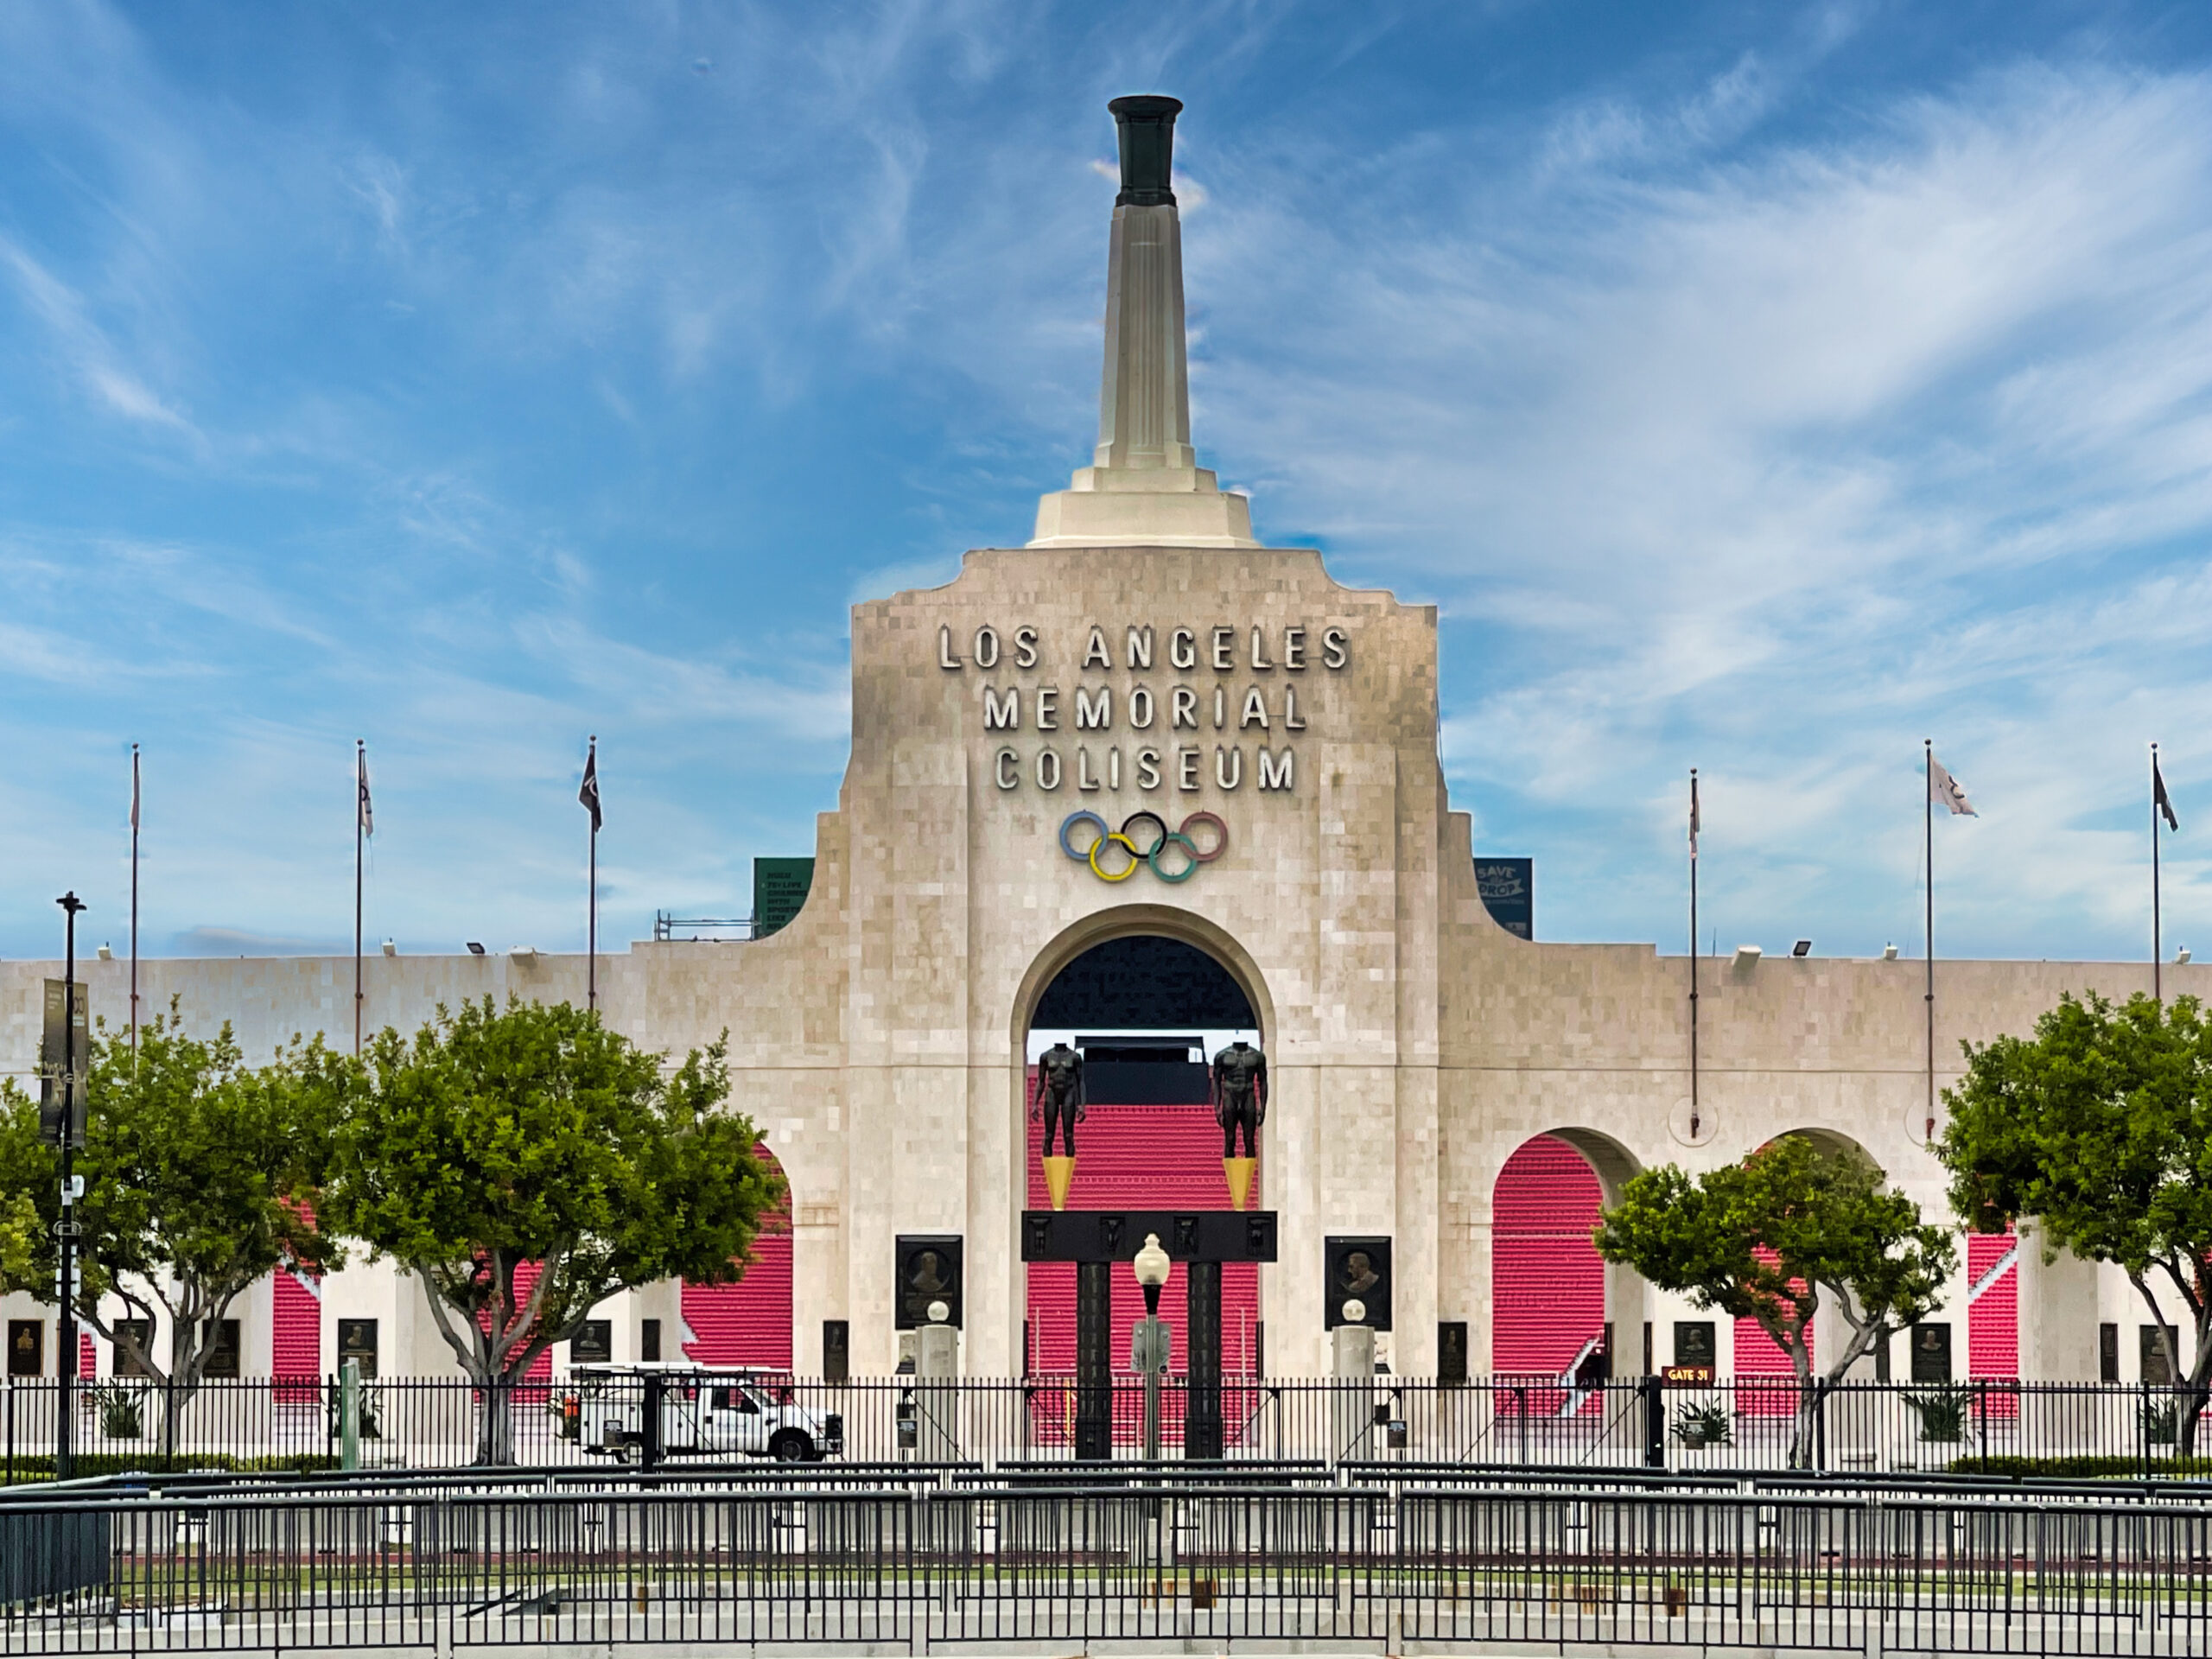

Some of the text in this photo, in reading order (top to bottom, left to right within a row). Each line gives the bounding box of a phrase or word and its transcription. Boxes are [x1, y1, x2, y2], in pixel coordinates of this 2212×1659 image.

[938, 625, 1347, 670] LOS ANGELES
[983, 685, 1306, 730] MEMORIAL
[995, 745, 1294, 791] COLISEUM
[1477, 865, 1516, 879] SAVE
[1668, 1369, 1708, 1381] GATE 31
